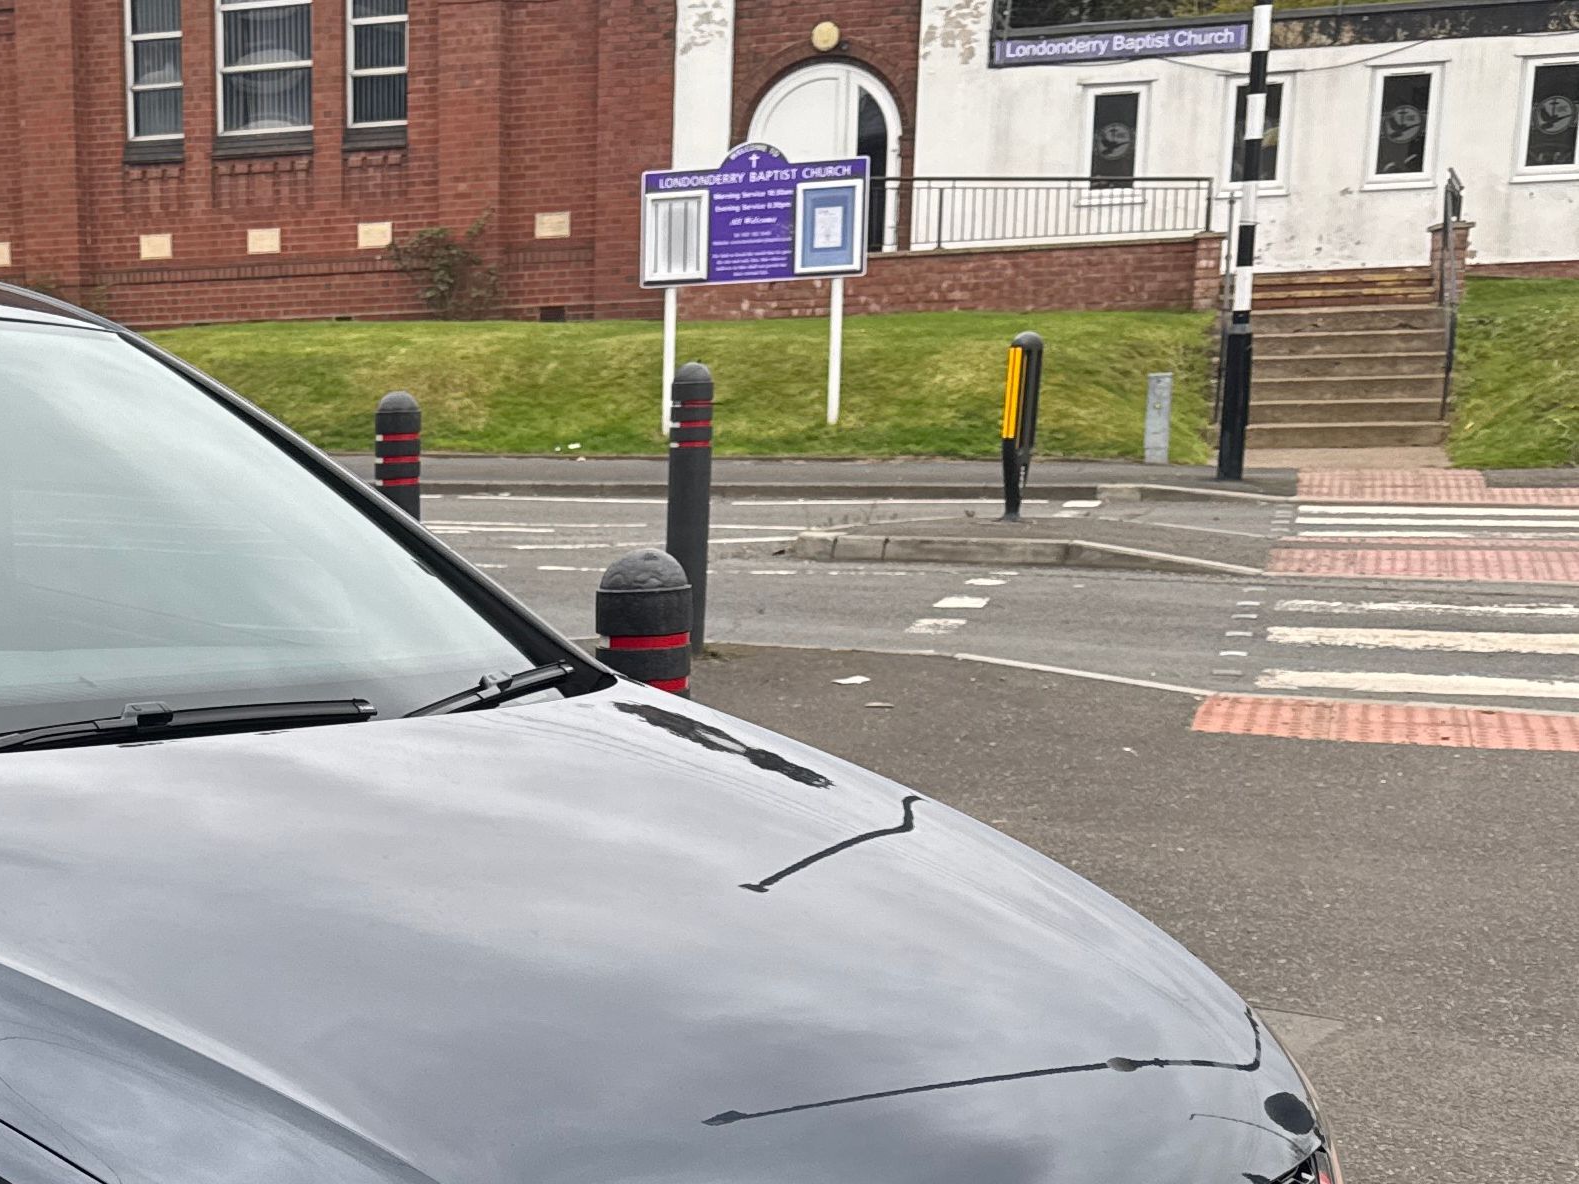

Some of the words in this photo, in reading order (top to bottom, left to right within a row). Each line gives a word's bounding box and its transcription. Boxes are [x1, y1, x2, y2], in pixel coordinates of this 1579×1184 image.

[1006, 38, 1109, 58] Londonderry
[1113, 33, 1169, 52] Baptist
[1174, 28, 1235, 46] Church
[659, 172, 745, 189] LONDONDERRY
[749, 168, 797, 183] BAPTIST
[802, 165, 852, 179] CHURCH
